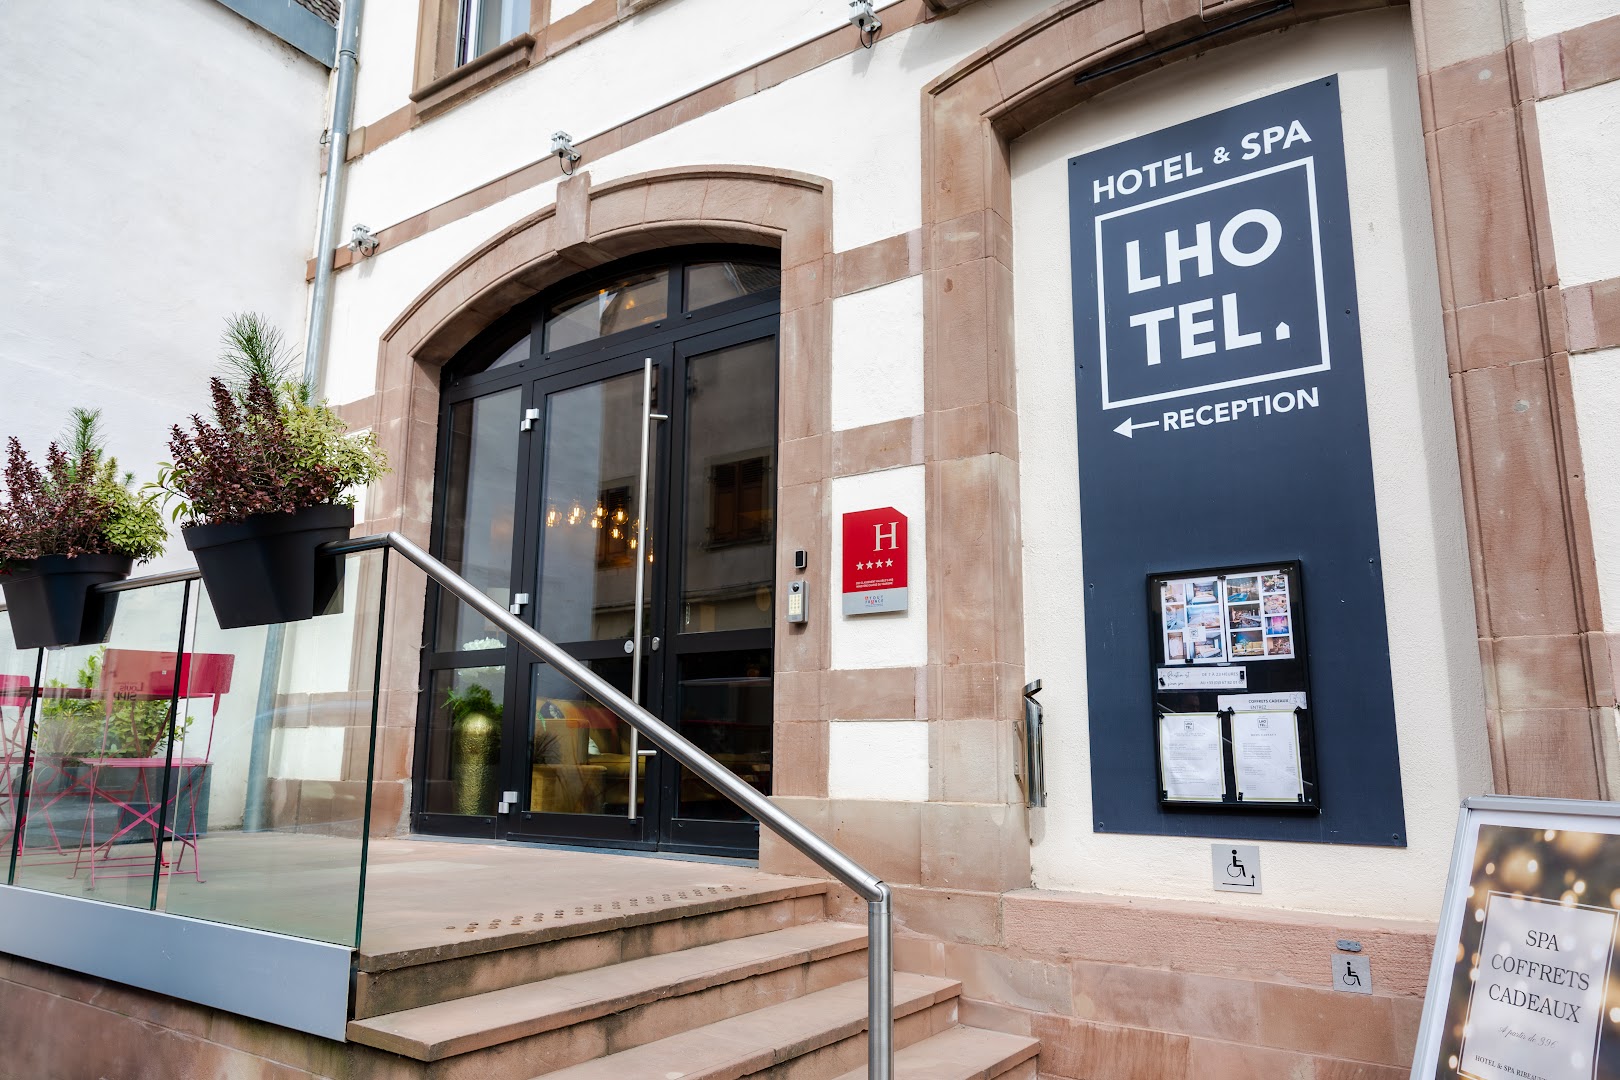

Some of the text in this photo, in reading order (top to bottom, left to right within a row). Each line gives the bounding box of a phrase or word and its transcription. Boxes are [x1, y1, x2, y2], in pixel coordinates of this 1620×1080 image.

[1093, 119, 1312, 203] HOTEL & SPA
[1126, 208, 1282, 294] LHO
[1163, 387, 1319, 432] RECEPTION
[872, 521, 899, 552] H
[1525, 929, 1560, 952] SPA
[1491, 953, 1590, 991] COFFRETS
[1488, 983, 1581, 1023] CADEAUX
[1504, 1029, 1526, 1040] partir
[1527, 1033, 1537, 1042] de
[1475, 1054, 1496, 1068] HOTEL
[1496, 1062, 1503, 1070] &
[1503, 1064, 1515, 1075] SPA
